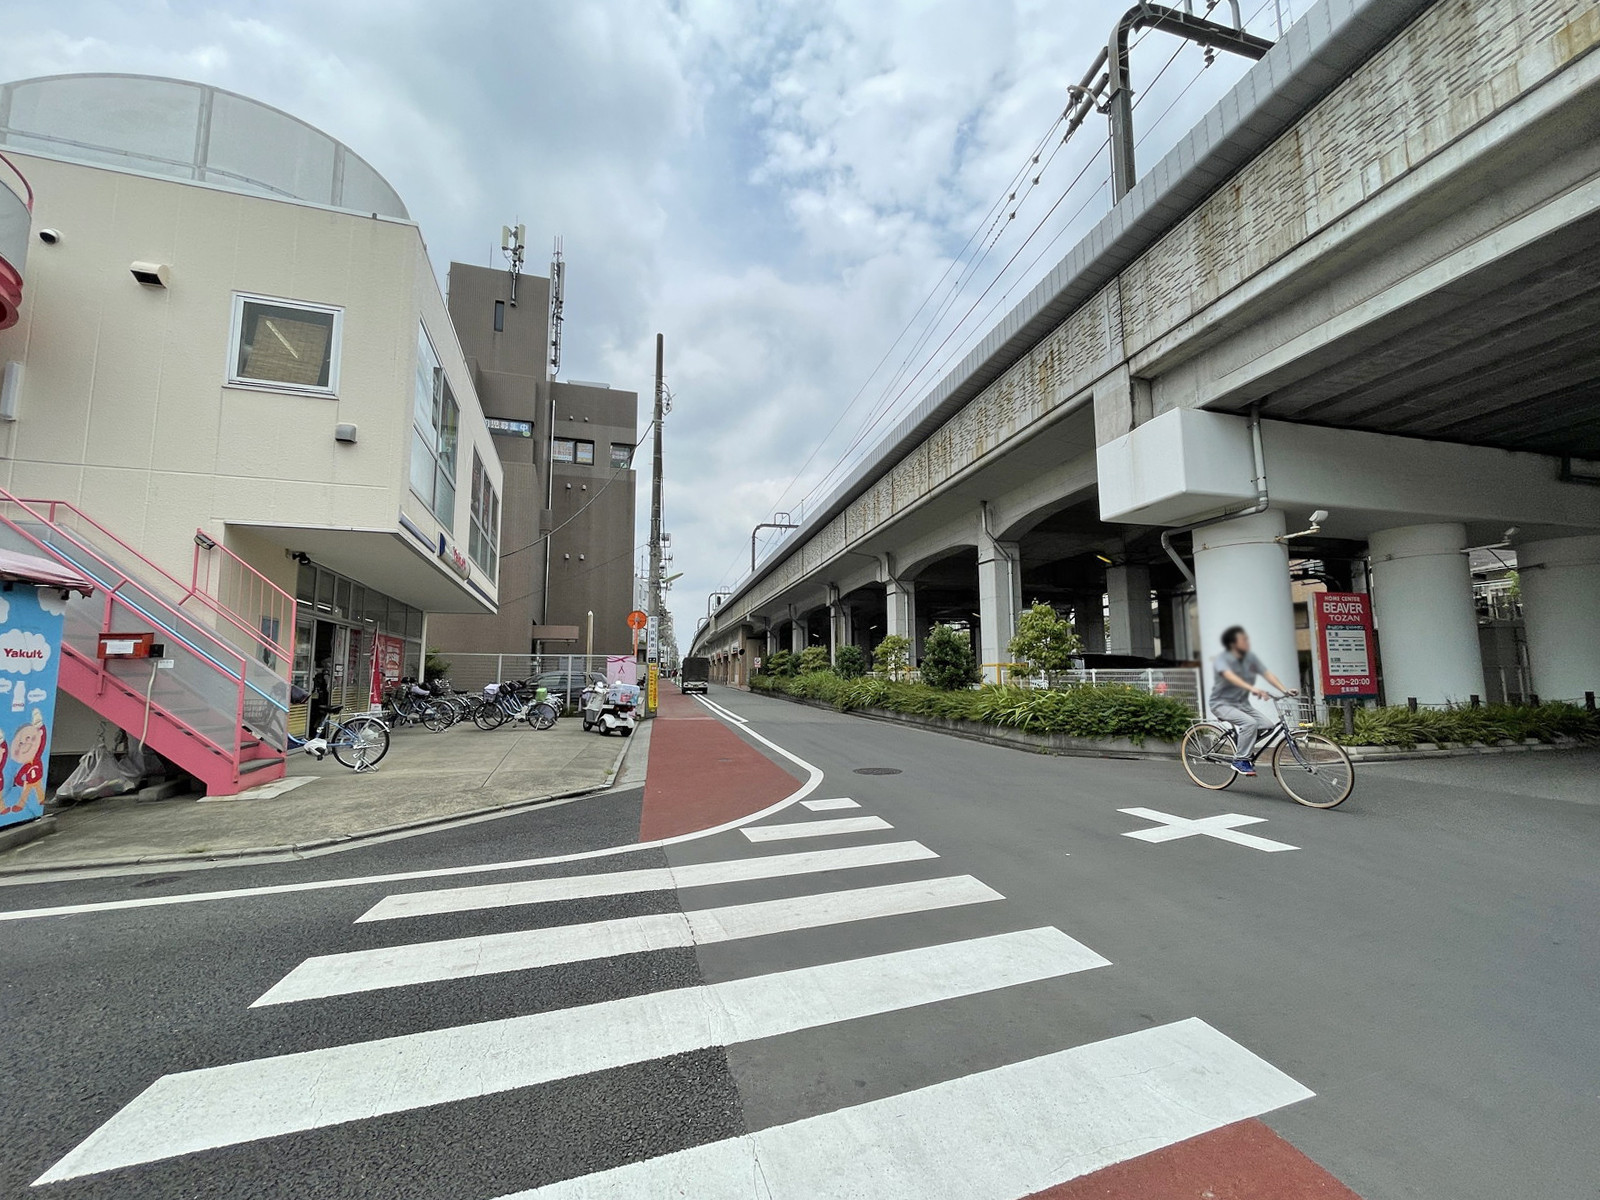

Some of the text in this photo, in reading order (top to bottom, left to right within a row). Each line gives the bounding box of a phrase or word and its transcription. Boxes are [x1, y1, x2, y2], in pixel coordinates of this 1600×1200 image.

[1323, 602, 1364, 614] BEAVER
[1329, 614, 1360, 622] TOZAN
[4, 648, 44, 659] Yakult
